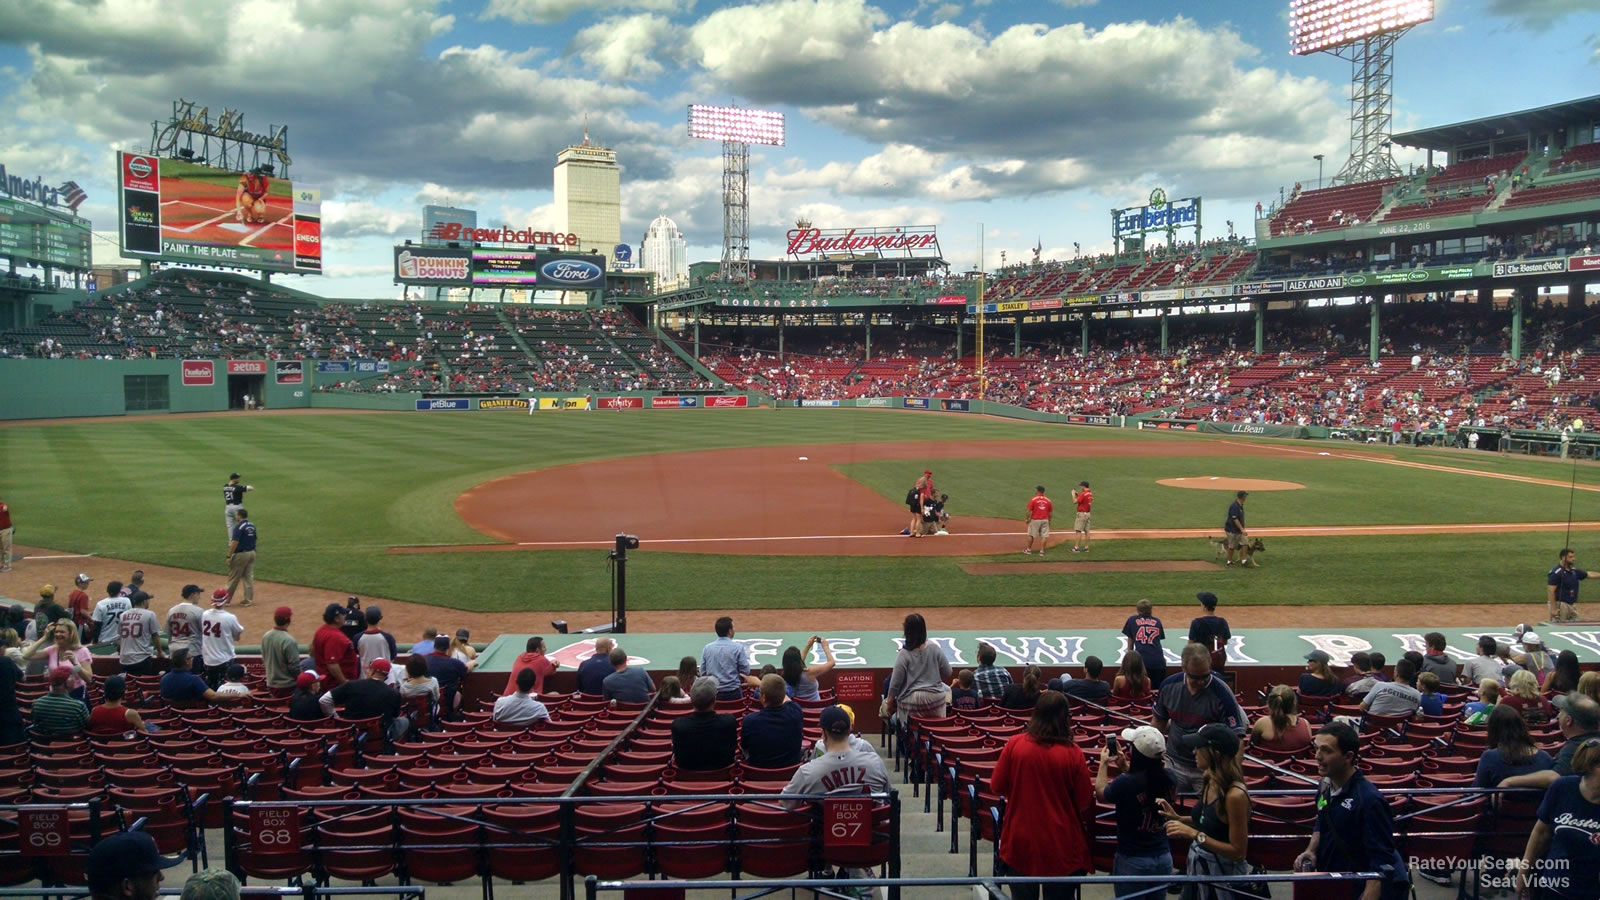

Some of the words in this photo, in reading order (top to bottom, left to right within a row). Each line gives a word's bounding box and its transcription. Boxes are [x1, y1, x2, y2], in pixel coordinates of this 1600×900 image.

[156, 98, 213, 151] John
[215, 107, 292, 165] Hancock
[130, 163, 150, 171] NISSAN
[1117, 199, 1195, 231] Cumberland
[1379, 225, 1397, 235] JUNE
[1399, 224, 1411, 233] 22,
[1413, 222, 1431, 231] 2016
[296, 234, 320, 243] ENEOS
[463, 227, 502, 243] new
[503, 226, 577, 246] balance
[786, 228, 936, 255] Budweiser
[164, 242, 190, 254] PAINT
[193, 245, 209, 256] THE
[211, 247, 237, 259] PLATE
[419, 257, 468, 268] DUNKIN'
[1507, 265, 1519, 274] The
[1519, 263, 1542, 273] Boston
[1543, 261, 1562, 271] Globe
[419, 268, 465, 278] DONUTS
[553, 263, 590, 280] Ford
[1496, 265, 1504, 275] B
[1289, 281, 1307, 290] ALEX
[1308, 279, 1326, 289] AND
[1326, 278, 1341, 287] ANI
[938, 296, 966, 304] Budweiser
[233, 362, 261, 372] aetna
[277, 367, 302, 375] Safelite
[430, 400, 456, 410] jetBlue
[480, 399, 511, 408] GRANITE
[512, 399, 528, 408] CITY
[608, 399, 633, 408] xfiity
[1231, 424, 1264, 434] L.L.Bean
[225, 491, 234, 501] 21
[106, 602, 126, 610] ABREU
[123, 613, 142, 621] BETTS
[120, 622, 143, 638] 50
[169, 621, 190, 637] 34
[203, 620, 221, 638] 24
[1135, 626, 1160, 644] 47
[821, 767, 867, 791] ORTIZ
[832, 803, 863, 811] FIELD
[29, 813, 59, 821] FIELD
[259, 810, 290, 818] FIELD
[33, 821, 55, 829] BOX
[263, 818, 286, 826] BOX
[831, 822, 862, 837] 67
[29, 832, 61, 846] 69
[259, 829, 291, 844] 68
